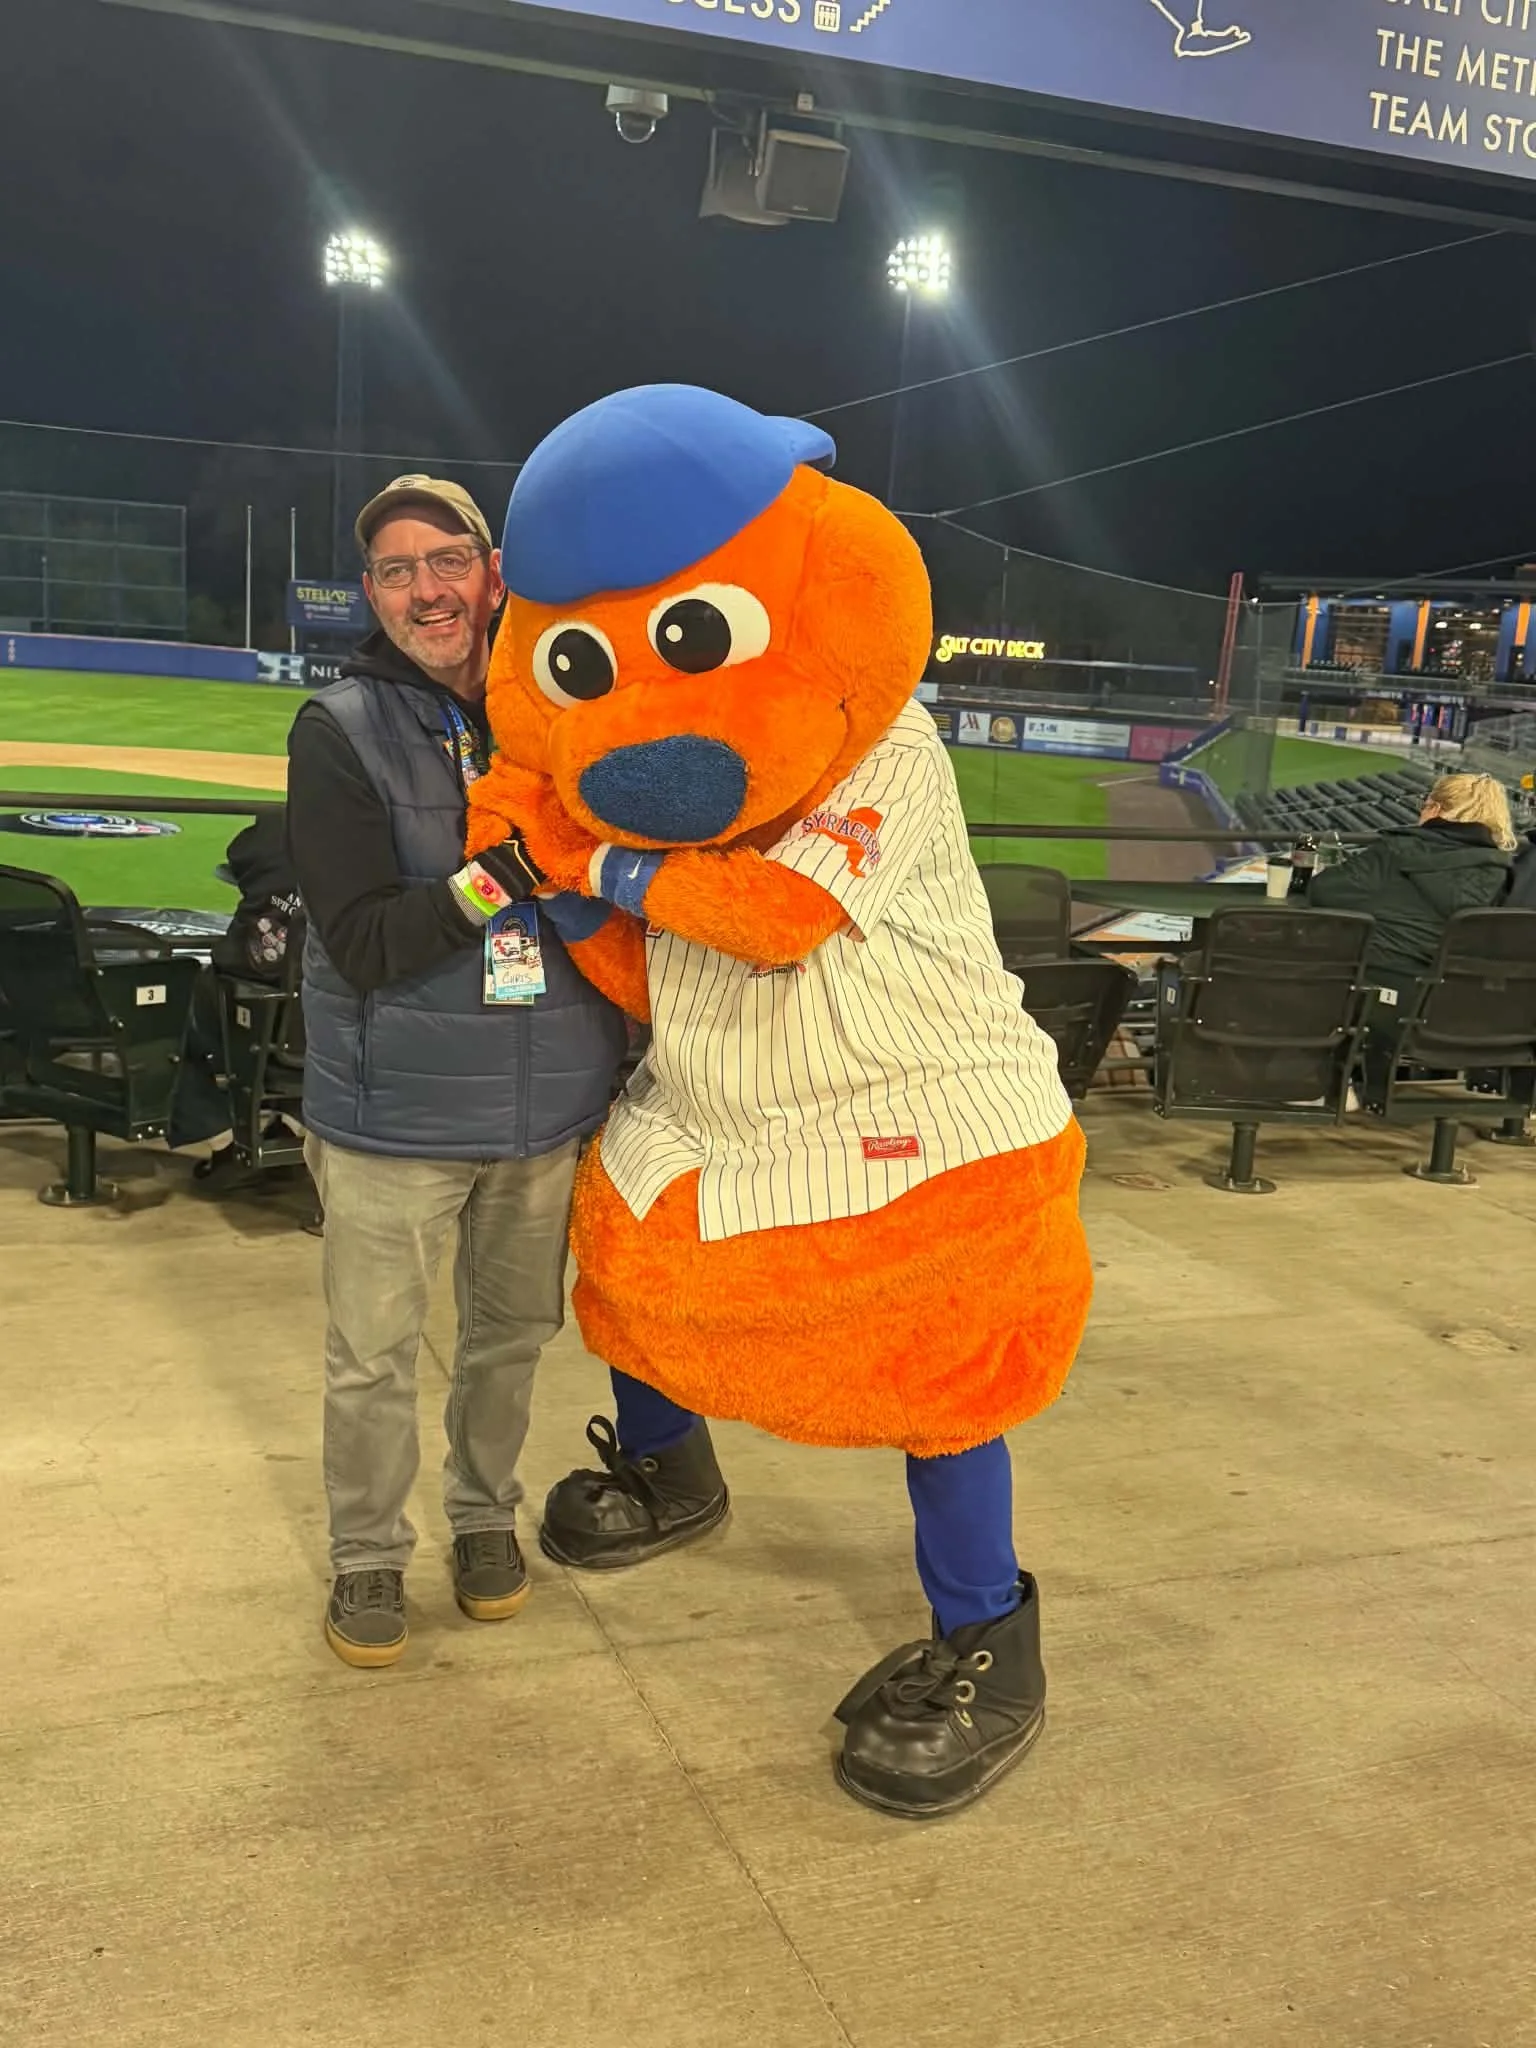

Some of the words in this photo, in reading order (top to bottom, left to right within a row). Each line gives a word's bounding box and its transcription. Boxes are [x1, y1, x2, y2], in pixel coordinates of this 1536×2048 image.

[1376, 29, 1444, 78] THE
[1455, 44, 1536, 97] MET
[1369, 92, 1468, 146] TEAM
[969, 638, 1006, 657] CITY
[1006, 640, 1045, 660] DECK
[801, 809, 882, 866] SYRACUSE
[147, 989, 155, 1002] 3
